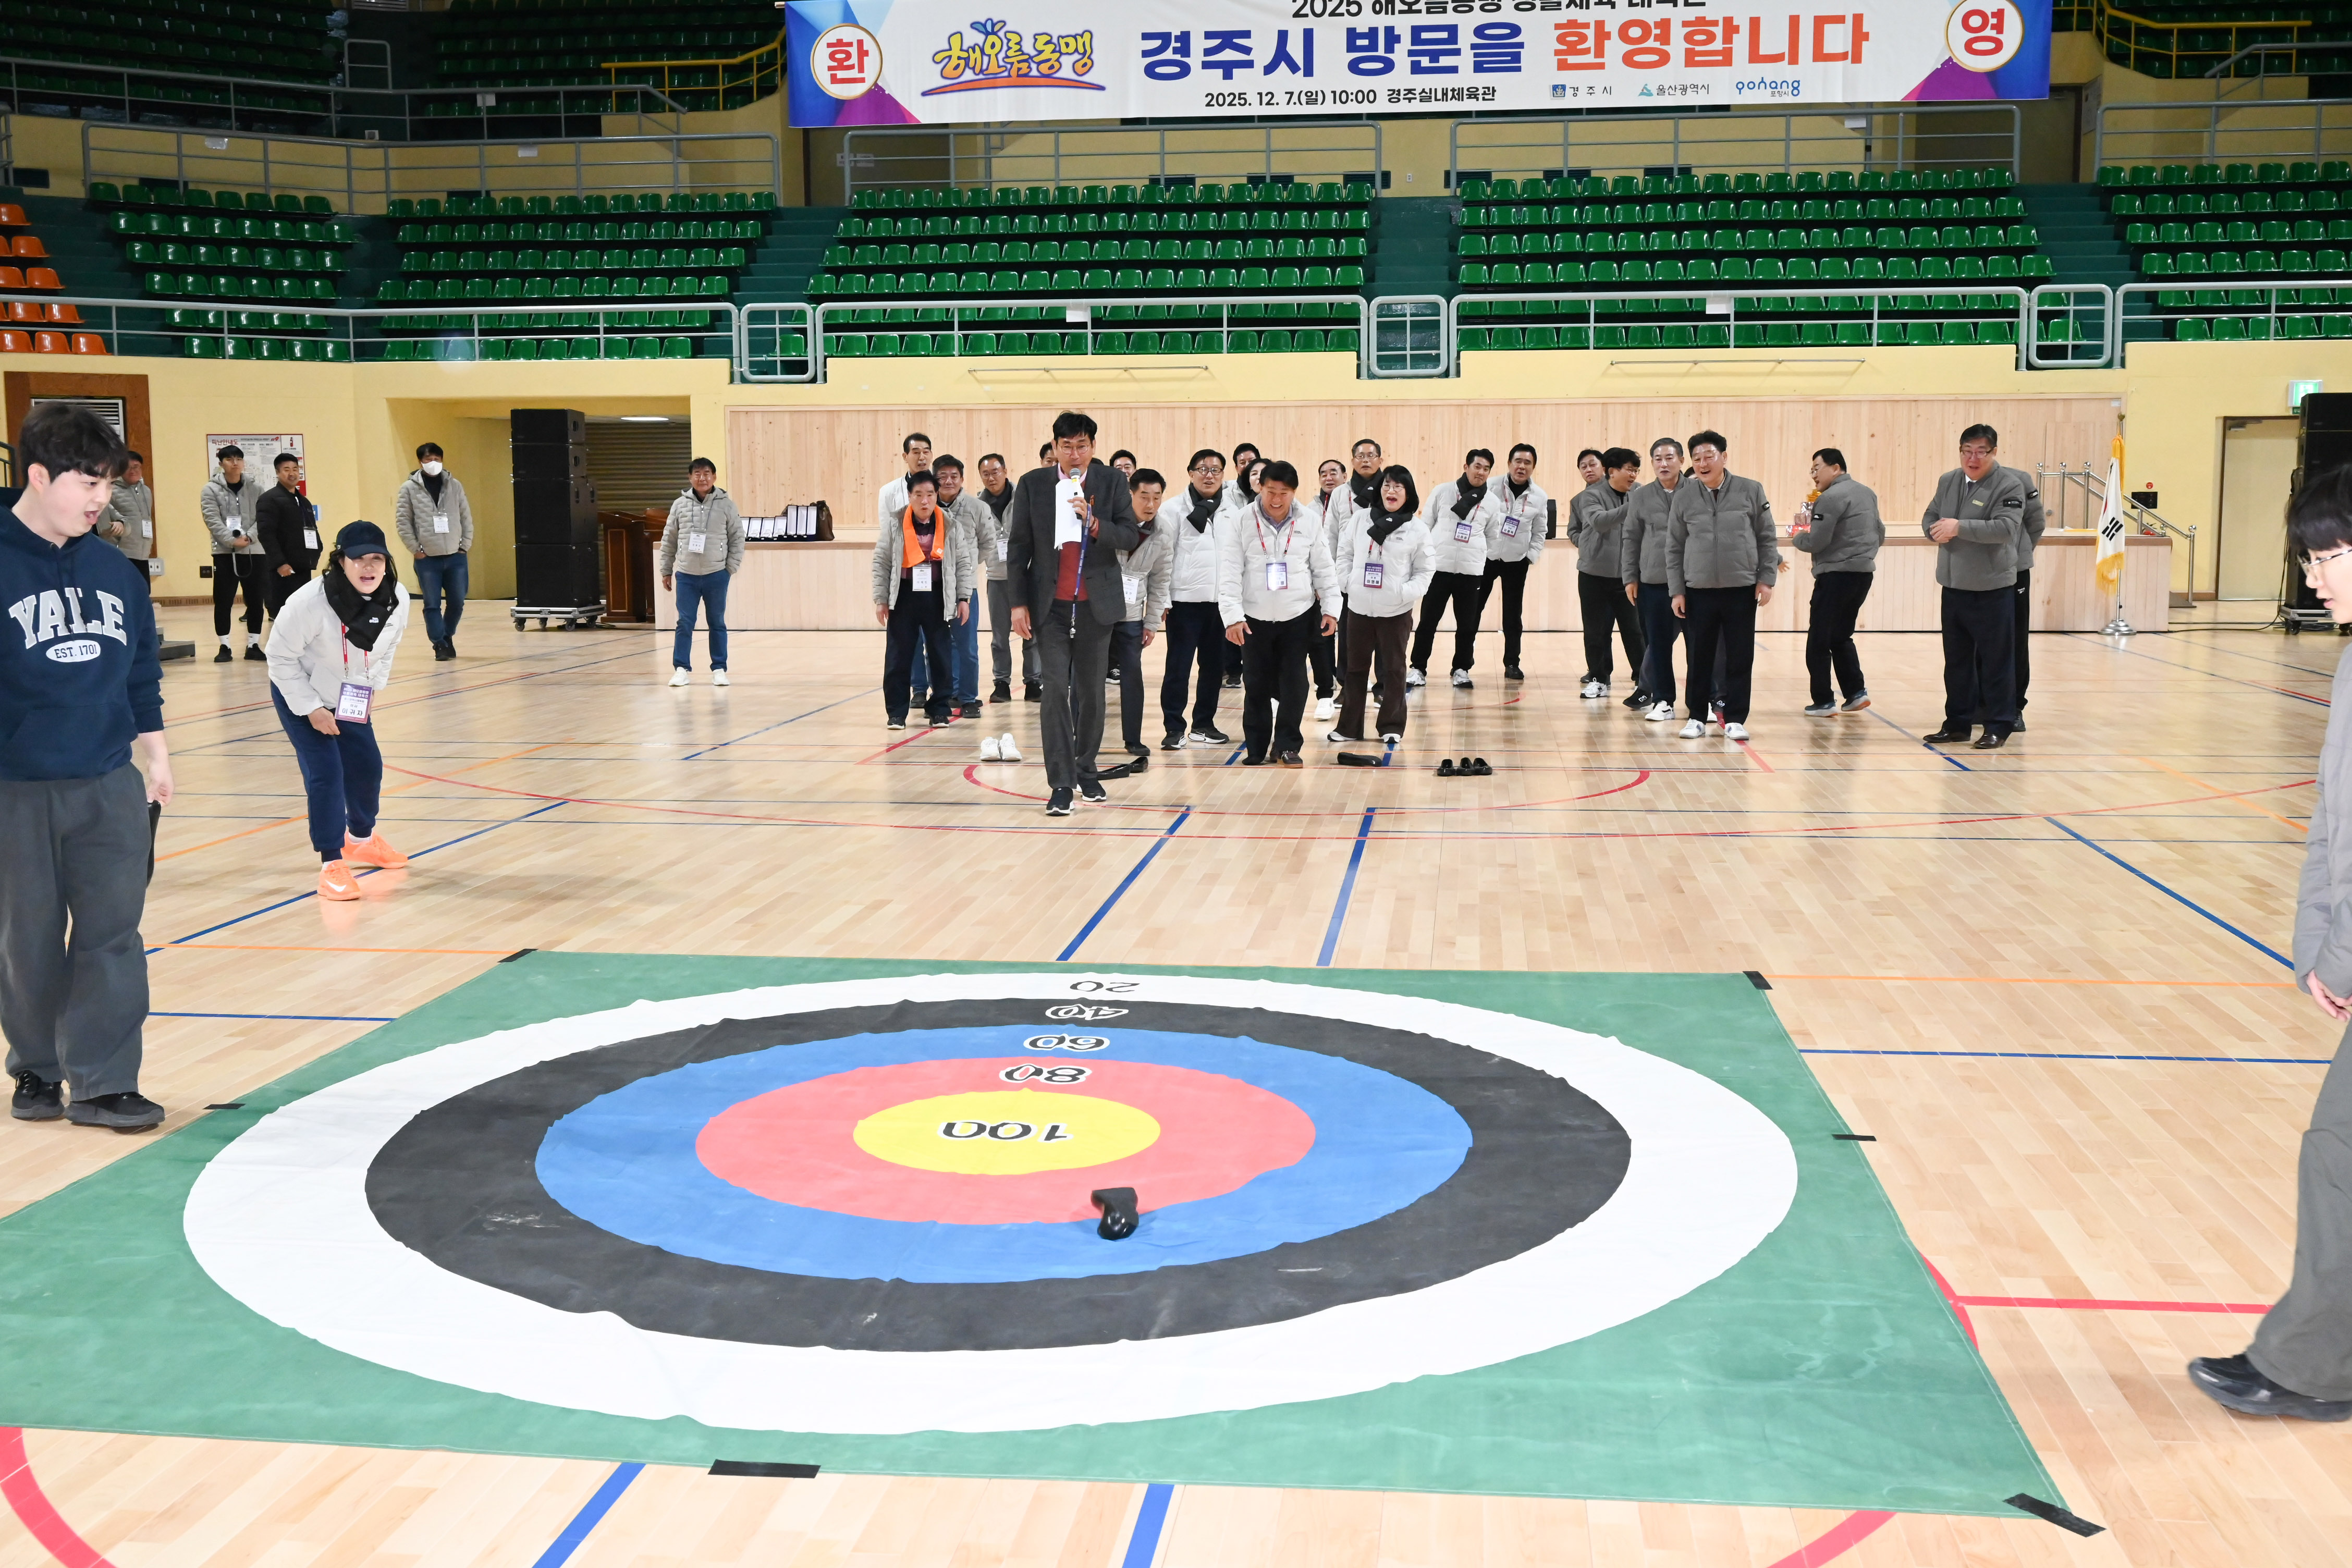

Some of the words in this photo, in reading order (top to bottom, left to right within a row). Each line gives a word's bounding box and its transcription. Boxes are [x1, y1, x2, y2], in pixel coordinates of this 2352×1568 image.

[1292, 0, 1362, 18] 2025
[1961, 7, 2005, 56] 영
[933, 29, 1094, 79] 해오름동맹
[1141, 28, 1314, 81] 경주시
[1346, 22, 1525, 76] 방문을
[1553, 13, 1870, 71] 환영합니다
[826, 38, 869, 84] 환
[1205, 92, 1252, 107] 2025.
[1257, 92, 1279, 106] 12.
[1285, 90, 1326, 105] 7.(일)
[1331, 90, 1377, 104] 10:00
[1387, 87, 1497, 104] 경주실내체육관
[1656, 83, 1709, 96] 울산광역시
[8, 587, 127, 649] YALE
[54, 648, 77, 659] EST.
[79, 644, 97, 655] 1701
[1070, 981, 1140, 993] 20
[1046, 1004, 1128, 1020] 40
[1024, 1034, 1109, 1051] 60
[1000, 1064, 1091, 1084] 80
[940, 1121, 1070, 1142] 100
